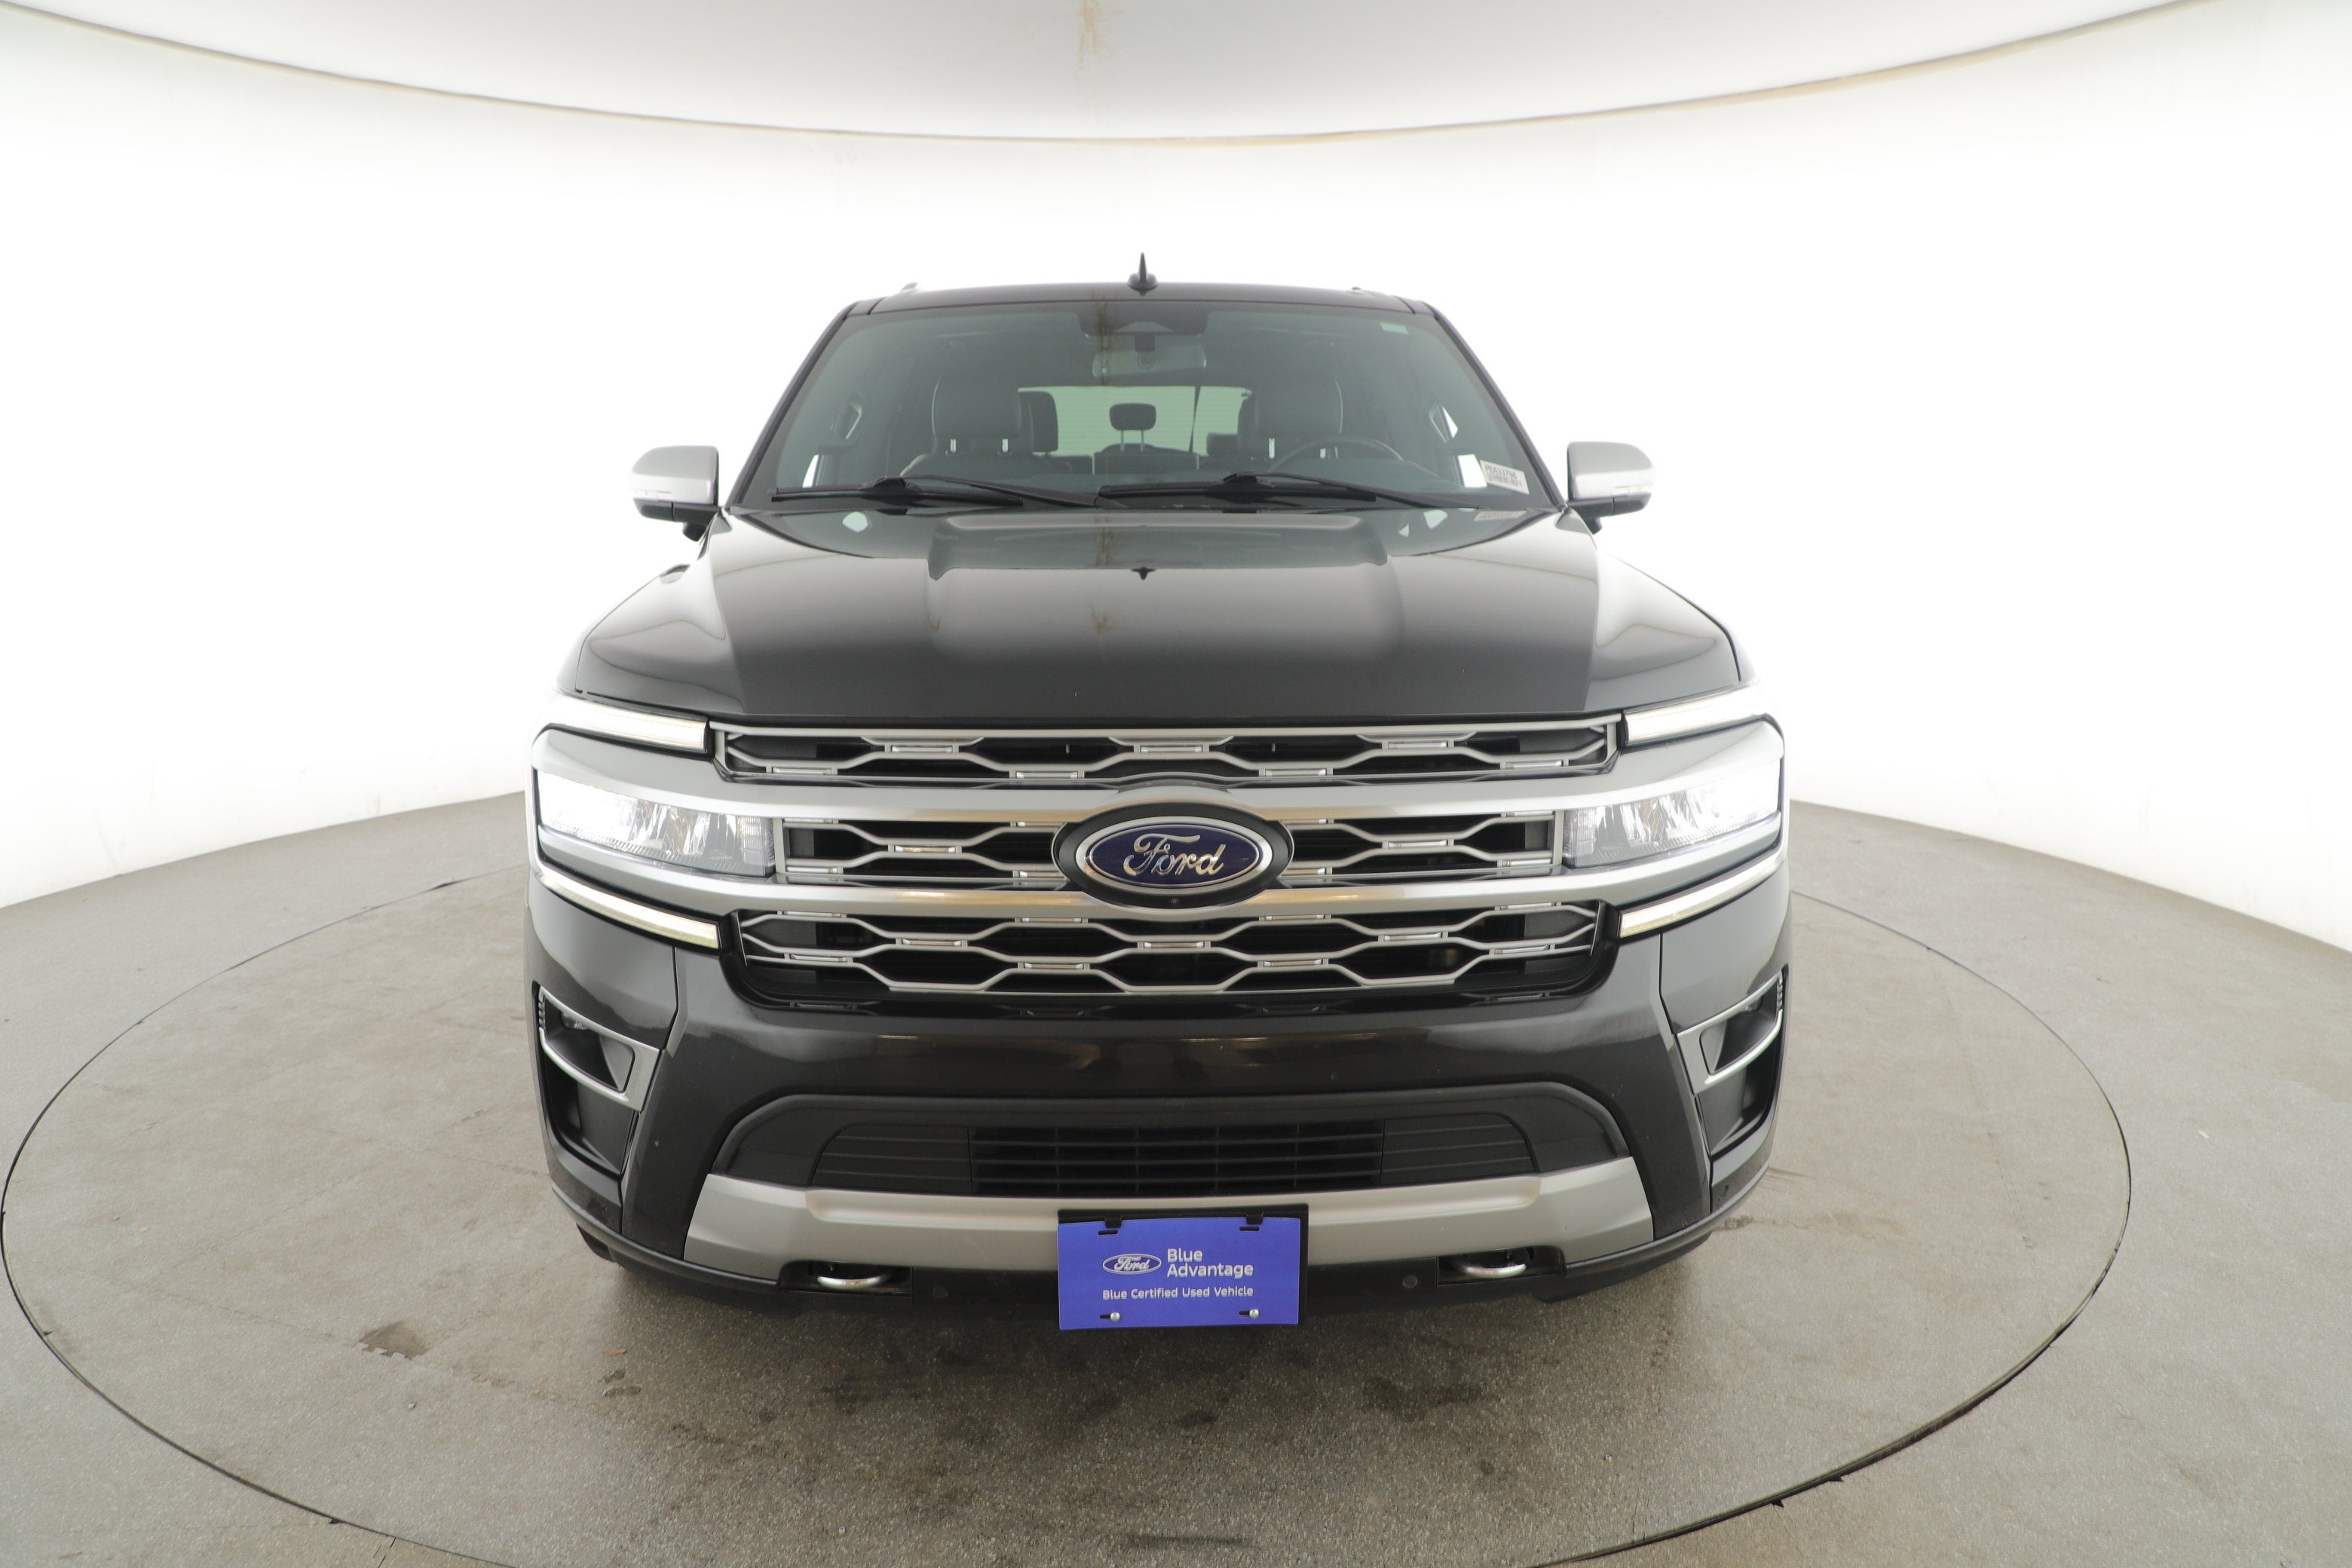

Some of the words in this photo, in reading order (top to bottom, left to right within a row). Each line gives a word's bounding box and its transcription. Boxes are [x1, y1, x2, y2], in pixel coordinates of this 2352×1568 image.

[1122, 833, 1226, 876] Ford
[1167, 1248, 1203, 1263] Blue
[1113, 1256, 1151, 1271] Ford
[1167, 1263, 1254, 1279] Advantage
[1102, 1289, 1127, 1300] Blue
[1131, 1287, 1178, 1300] Certified
[1182, 1286, 1210, 1298] Used
[1214, 1285, 1254, 1297] Vehicle
